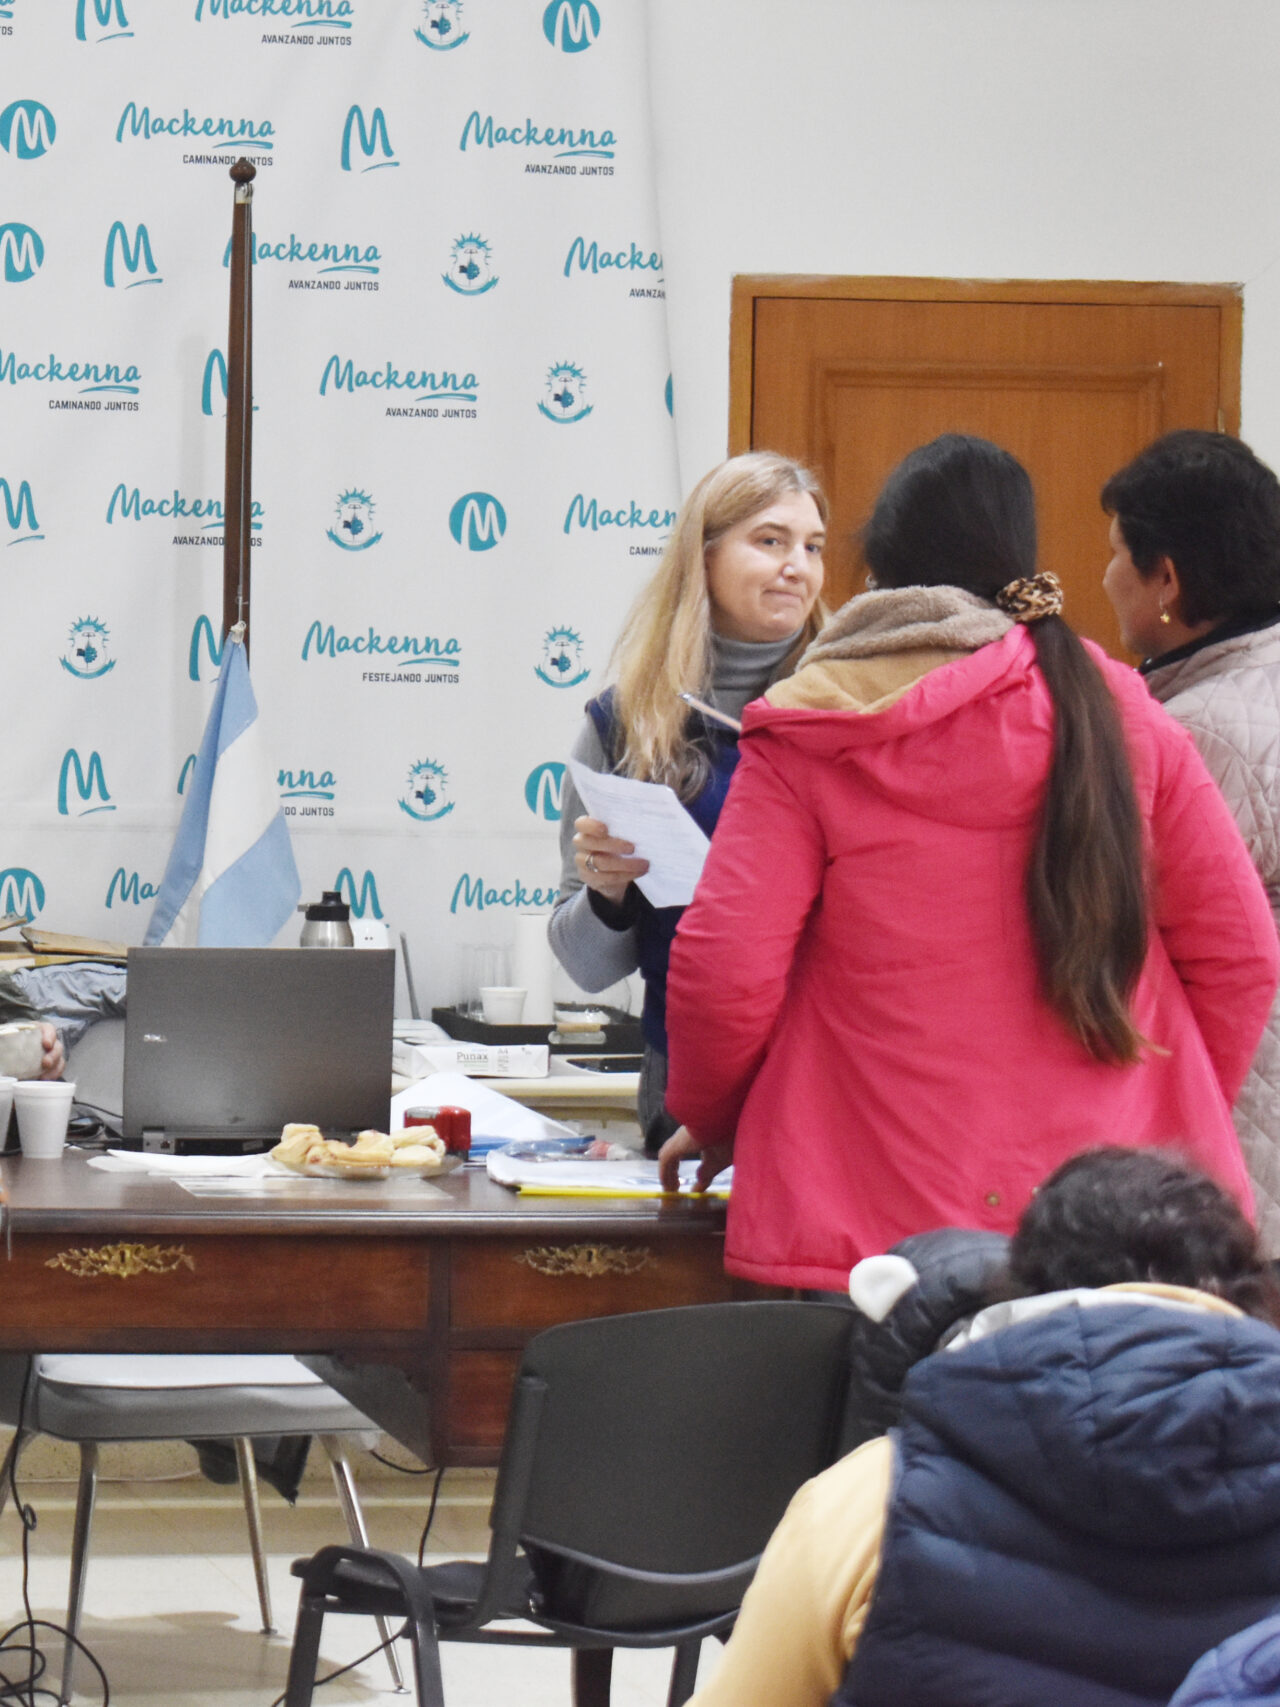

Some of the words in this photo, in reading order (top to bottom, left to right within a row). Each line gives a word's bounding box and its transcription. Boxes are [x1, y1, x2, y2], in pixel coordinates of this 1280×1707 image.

[261, 34, 314, 46] AVANZANDO
[316, 36, 352, 46] JUNTOS
[116, 102, 275, 142] Mackenna
[341, 105, 394, 171] M
[460, 111, 616, 151] Mackenna
[182, 154, 236, 165] CAMINANDO
[247, 156, 273, 167] NTOS
[524, 164, 577, 176] AVANZANDO
[579, 166, 615, 176] JUNTOS
[104, 221, 157, 288] M
[564, 236, 663, 277] Macke
[288, 279, 341, 290] AVANZANDO
[343, 281, 379, 292] JUNTOS
[319, 354, 478, 395] Mackenna
[48, 399, 102, 411] CAMINANDO
[104, 401, 139, 412] JUNTOS
[385, 407, 439, 418] AVANZANDO
[441, 408, 477, 419] JUNTOS
[106, 483, 264, 524] Mackena
[563, 493, 677, 535] Macken
[301, 620, 461, 661] Mackenna
[362, 672, 422, 683] FESTEJANDO
[424, 673, 460, 684] JUNTOS
[58, 748, 111, 815] M
[299, 807, 335, 817] JUNTOS
